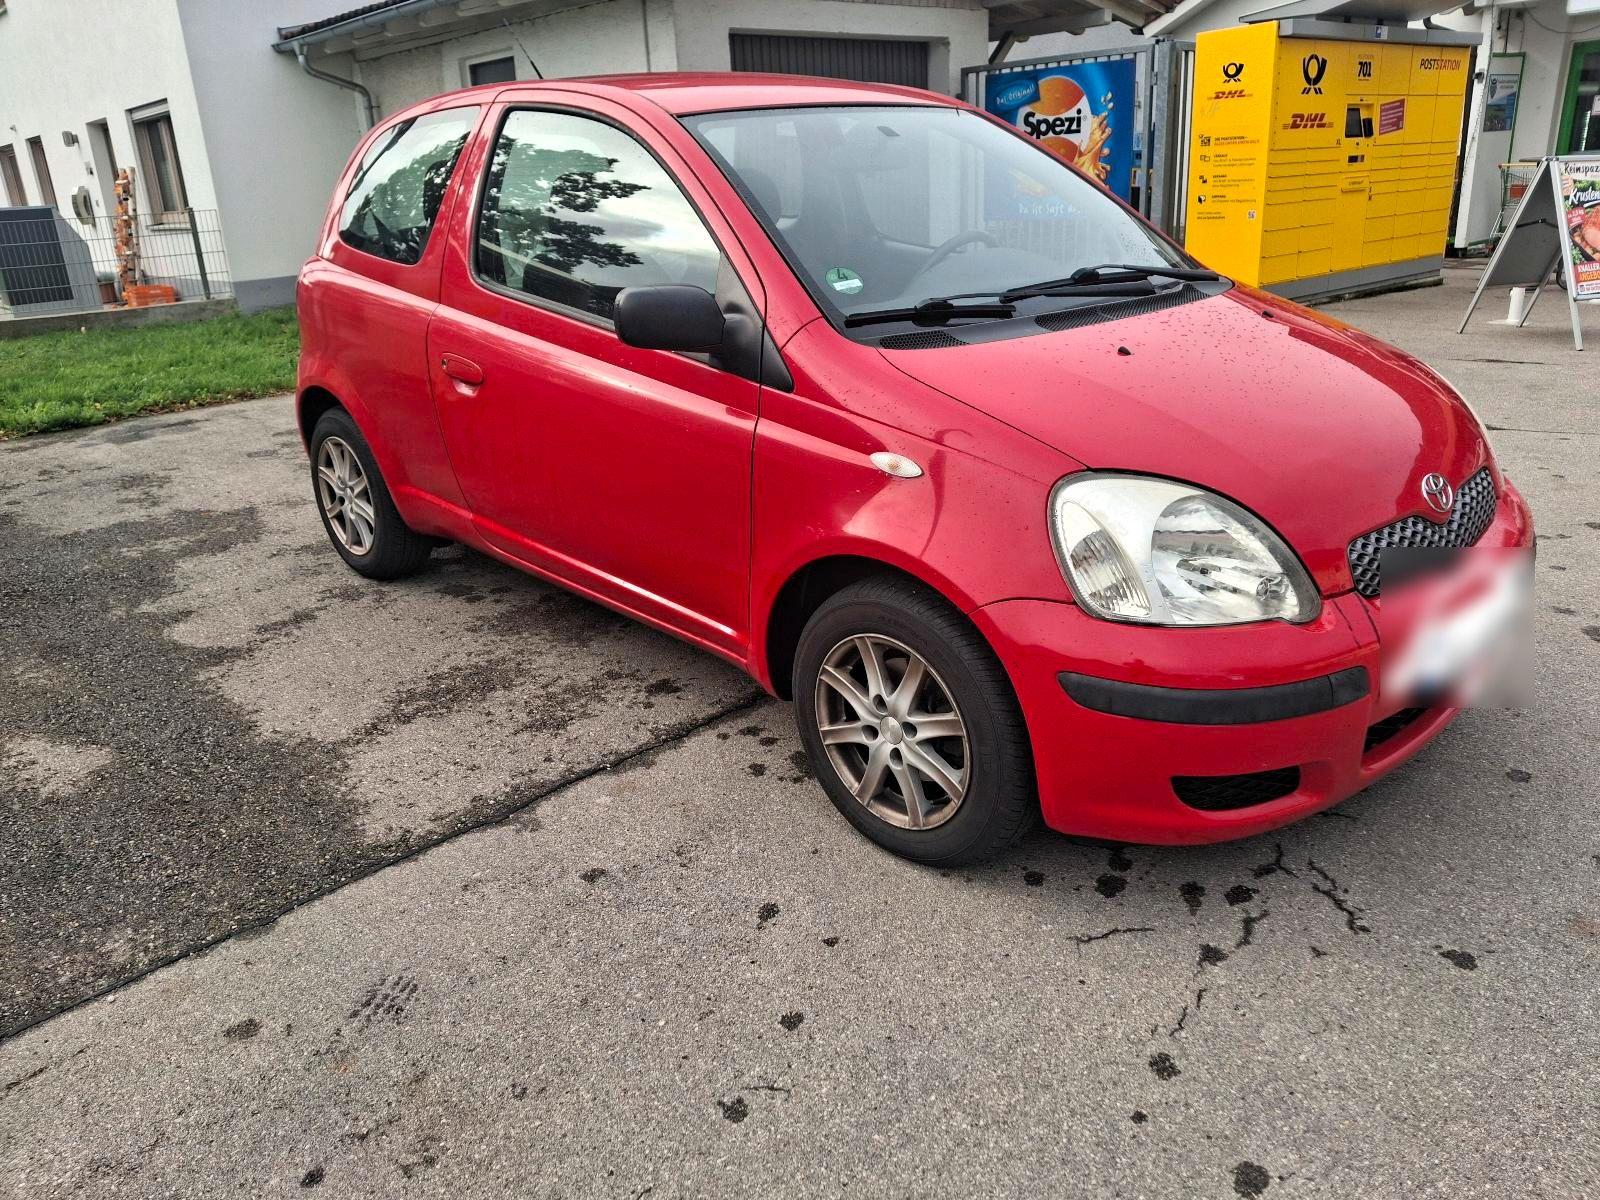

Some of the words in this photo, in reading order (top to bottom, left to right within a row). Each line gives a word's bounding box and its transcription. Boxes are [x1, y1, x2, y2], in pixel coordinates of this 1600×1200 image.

[1358, 61, 1371, 77] 701
[1420, 58, 1461, 70] POSTSTATION
[1214, 89, 1246, 99] DHL
[1024, 108, 1081, 139] Spezi
[1289, 113, 1327, 129] DHL
